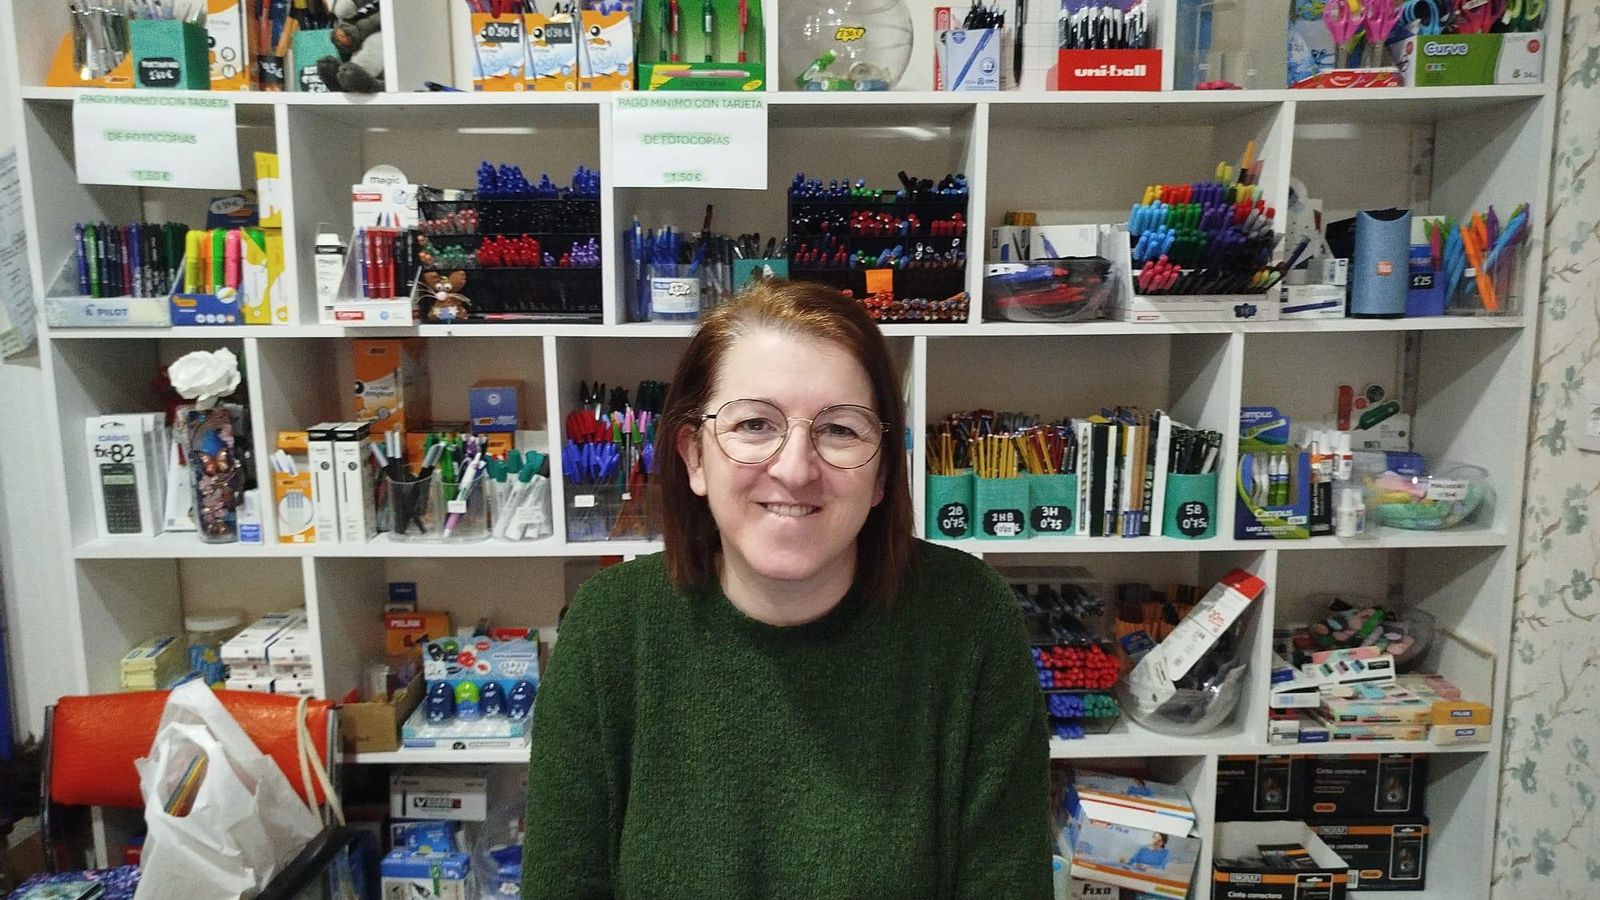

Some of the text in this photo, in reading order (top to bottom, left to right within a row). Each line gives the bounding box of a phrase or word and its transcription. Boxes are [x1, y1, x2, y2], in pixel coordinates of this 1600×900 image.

[1423, 42, 1469, 56] Curve
[1074, 64, 1147, 77] uni-ball
[79, 94, 112, 103] PAGO
[159, 97, 185, 106] CON
[618, 99, 648, 108] PAGO
[694, 99, 719, 108] CON
[722, 100, 763, 109] TARJETA
[644, 135, 731, 146] DE FOTOCOPIAS
[370, 177, 400, 186] magic
[97, 308, 128, 316] PILOT
[94, 443, 136, 463] fx-82
[948, 506, 963, 516] 2B
[1041, 506, 1058, 516] 3H
[1185, 504, 1202, 515] 5B
